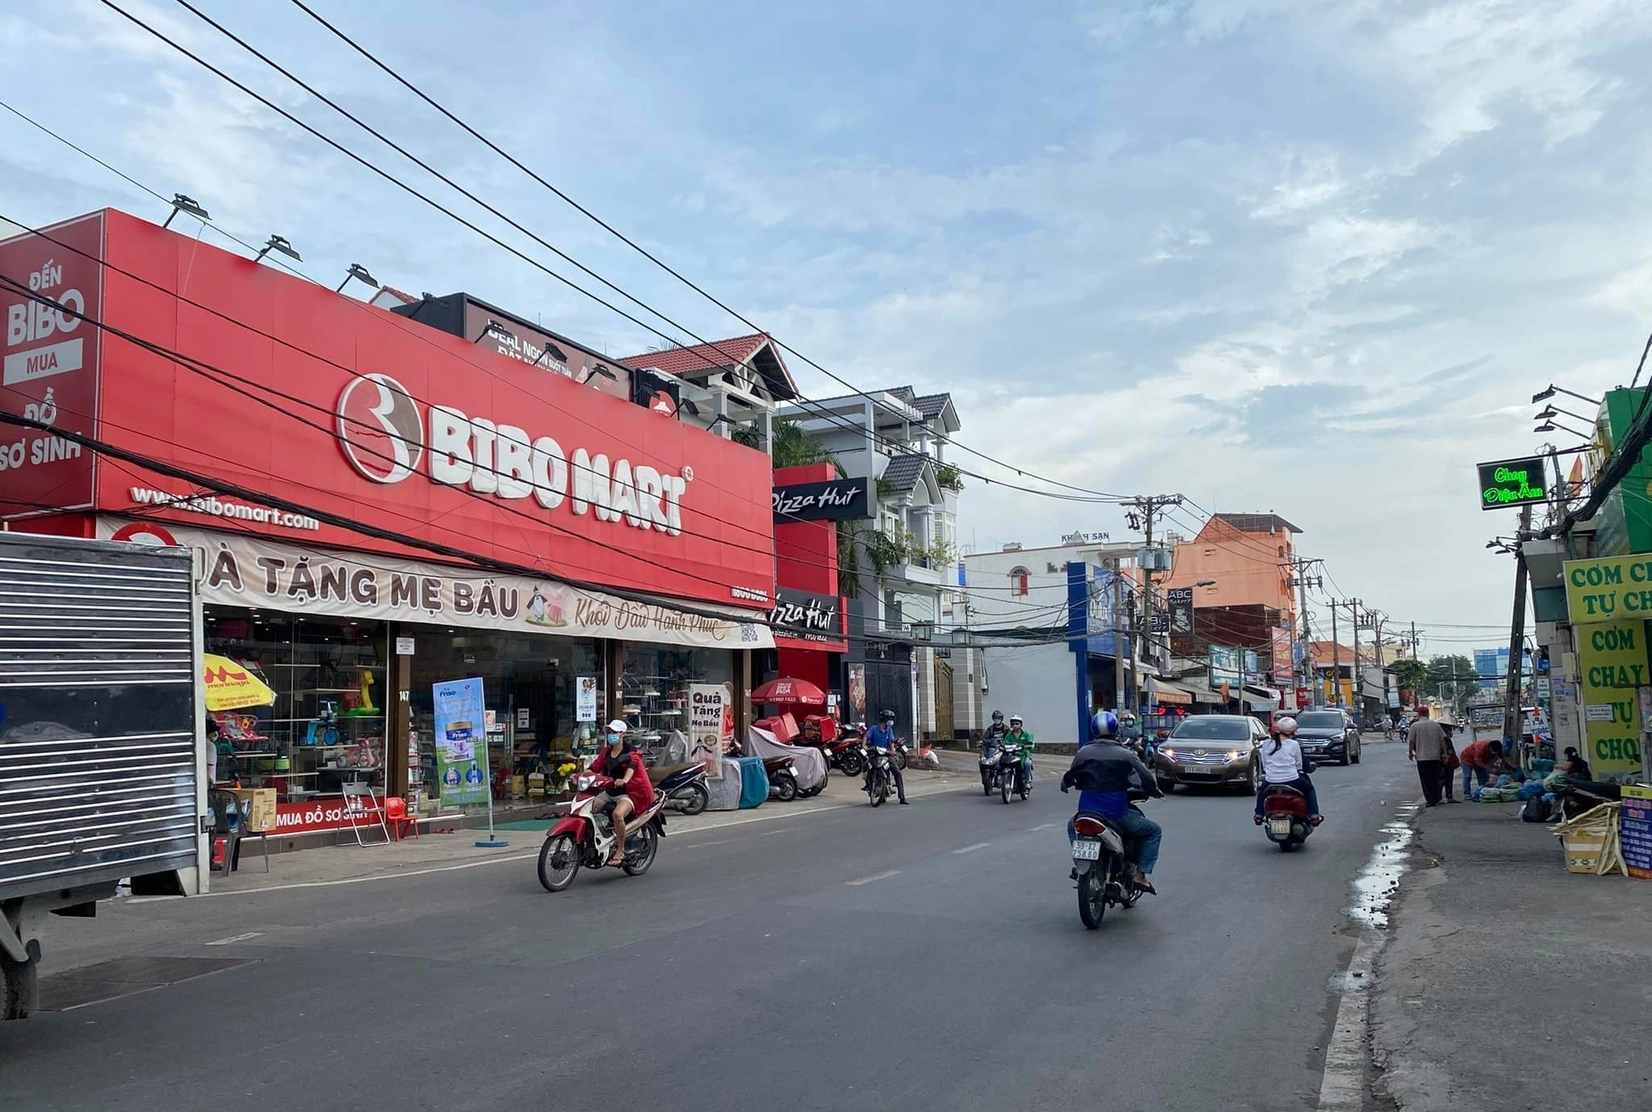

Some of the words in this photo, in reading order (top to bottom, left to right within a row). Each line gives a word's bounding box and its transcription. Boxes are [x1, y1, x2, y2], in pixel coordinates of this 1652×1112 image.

[29, 258, 62, 291] ĐẾN
[7, 289, 85, 346] BIBO
[26, 352, 58, 375] MUA
[24, 387, 57, 430] ĐỒ
[0, 438, 26, 471] SƠ
[30, 432, 82, 465] SINH
[428, 405, 568, 510] BIBO
[571, 448, 686, 536] MART
[818, 486, 862, 508] Hut
[1092, 532, 1110, 542] SẠN
[257, 556, 378, 605] TẶNG
[391, 573, 442, 616] MẸ
[453, 579, 519, 618] BẦU
[1571, 564, 1624, 587] CƠM
[1168, 590, 1192, 599] ABC
[1582, 590, 1617, 617] TỰ
[653, 606, 688, 635] Hạnh
[769, 593, 805, 626] izza
[805, 598, 836, 630] Hut
[1591, 625, 1636, 652] CƠM
[1588, 665, 1644, 688] CHAY
[399, 691, 410, 702] 147
[692, 692, 722, 704] Quà
[691, 720, 702, 728] Mẹ
[692, 705, 722, 718] Tặng
[1605, 697, 1634, 730] TỰ
[1595, 738, 1641, 766] CHỌ
[276, 813, 301, 826] MUA
[305, 805, 323, 824] ĐỒ
[325, 808, 341, 821] SƠ
